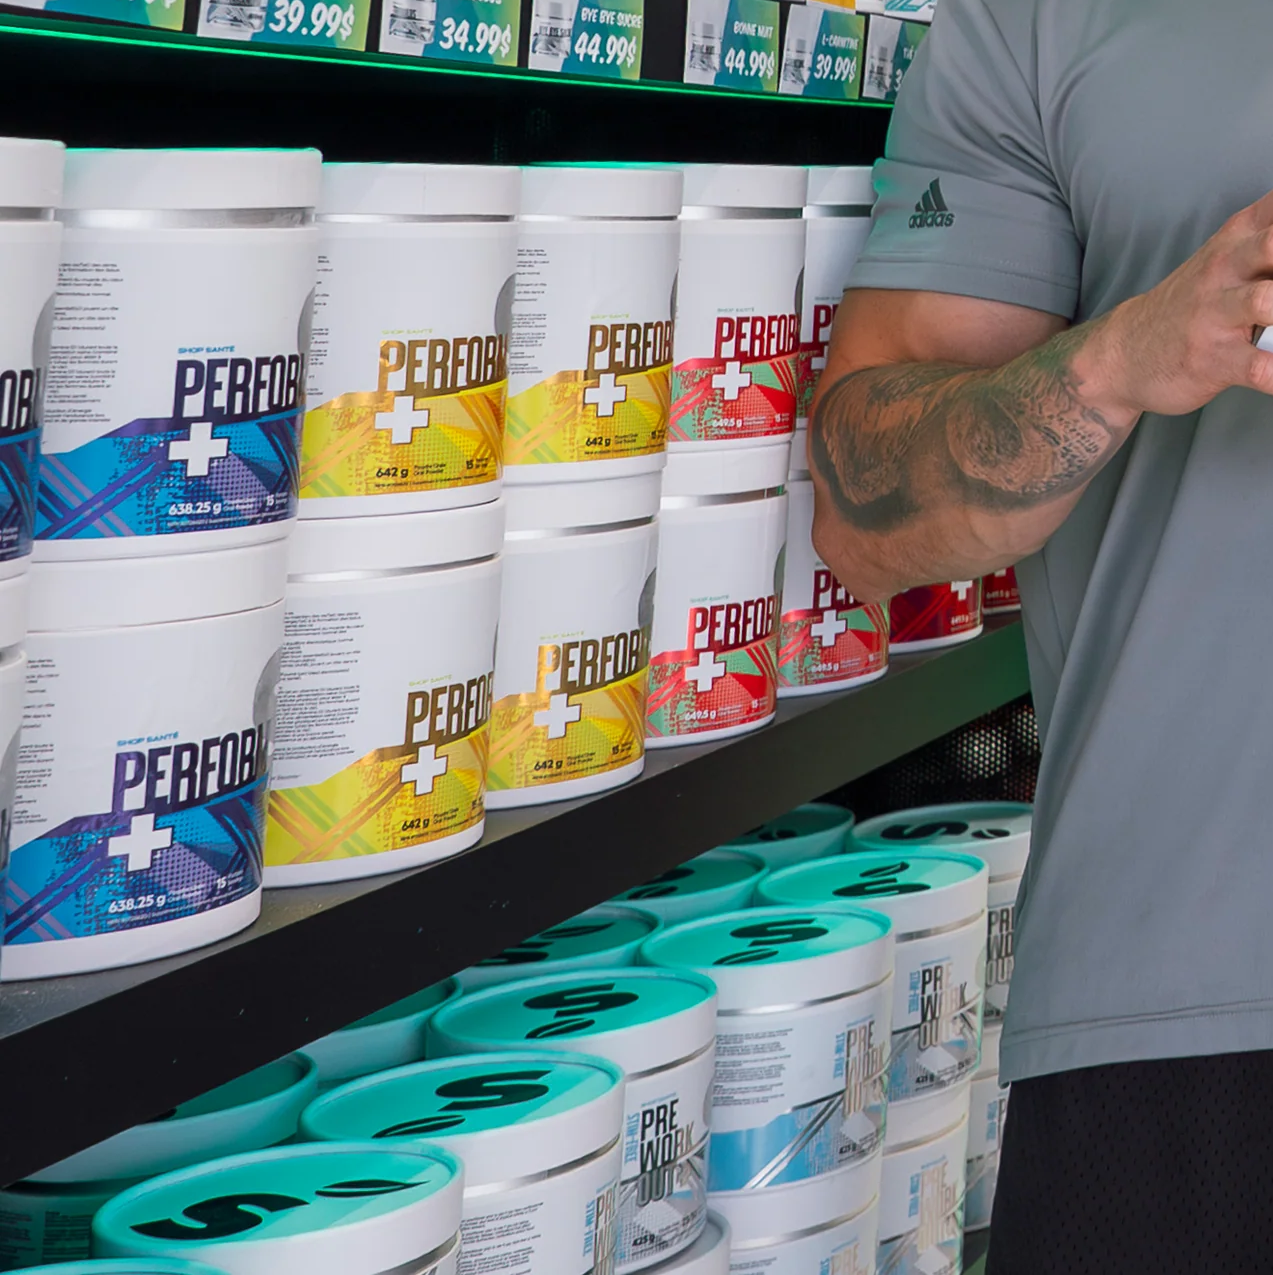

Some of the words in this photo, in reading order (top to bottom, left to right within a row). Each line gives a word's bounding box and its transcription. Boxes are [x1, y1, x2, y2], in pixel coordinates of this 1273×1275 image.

[581, 7, 597, 22] BYE
[600, 10, 615, 25] BYE
[617, 13, 642, 29] SUCRE
[733, 21, 756, 37] BONNE
[758, 24, 773, 39] NUIT
[439, 17, 512, 58] 34.99$
[574, 31, 637, 68] 44.99$
[724, 47, 775, 80] 44.99$
[813, 54, 857, 84] 39.99$
[908, 212, 955, 229] adidas
[714, 313, 800, 360] PERFOR
[178, 346, 204, 354] SHOP
[587, 320, 674, 380] PERFOR
[172, 353, 304, 420] PERFOR
[585, 436, 603, 447] 642
[376, 467, 398, 478] 642
[400, 467, 409, 479] g
[168, 501, 212, 516] 638.25
[213, 502, 221, 515] g
[687, 594, 779, 649] PERFOR
[536, 626, 650, 697] PERFOR
[404, 670, 494, 750] PERFOR
[117, 737, 144, 746] SHOP
[534, 759, 554, 771] 642
[555, 760, 563, 770] g
[402, 818, 421, 832] 642
[216, 877, 227, 889] 15
[108, 894, 154, 914] 638.25
[155, 894, 166, 907] g
[640, 1098, 679, 1142] PRE
[640, 1121, 694, 1175] WORK
